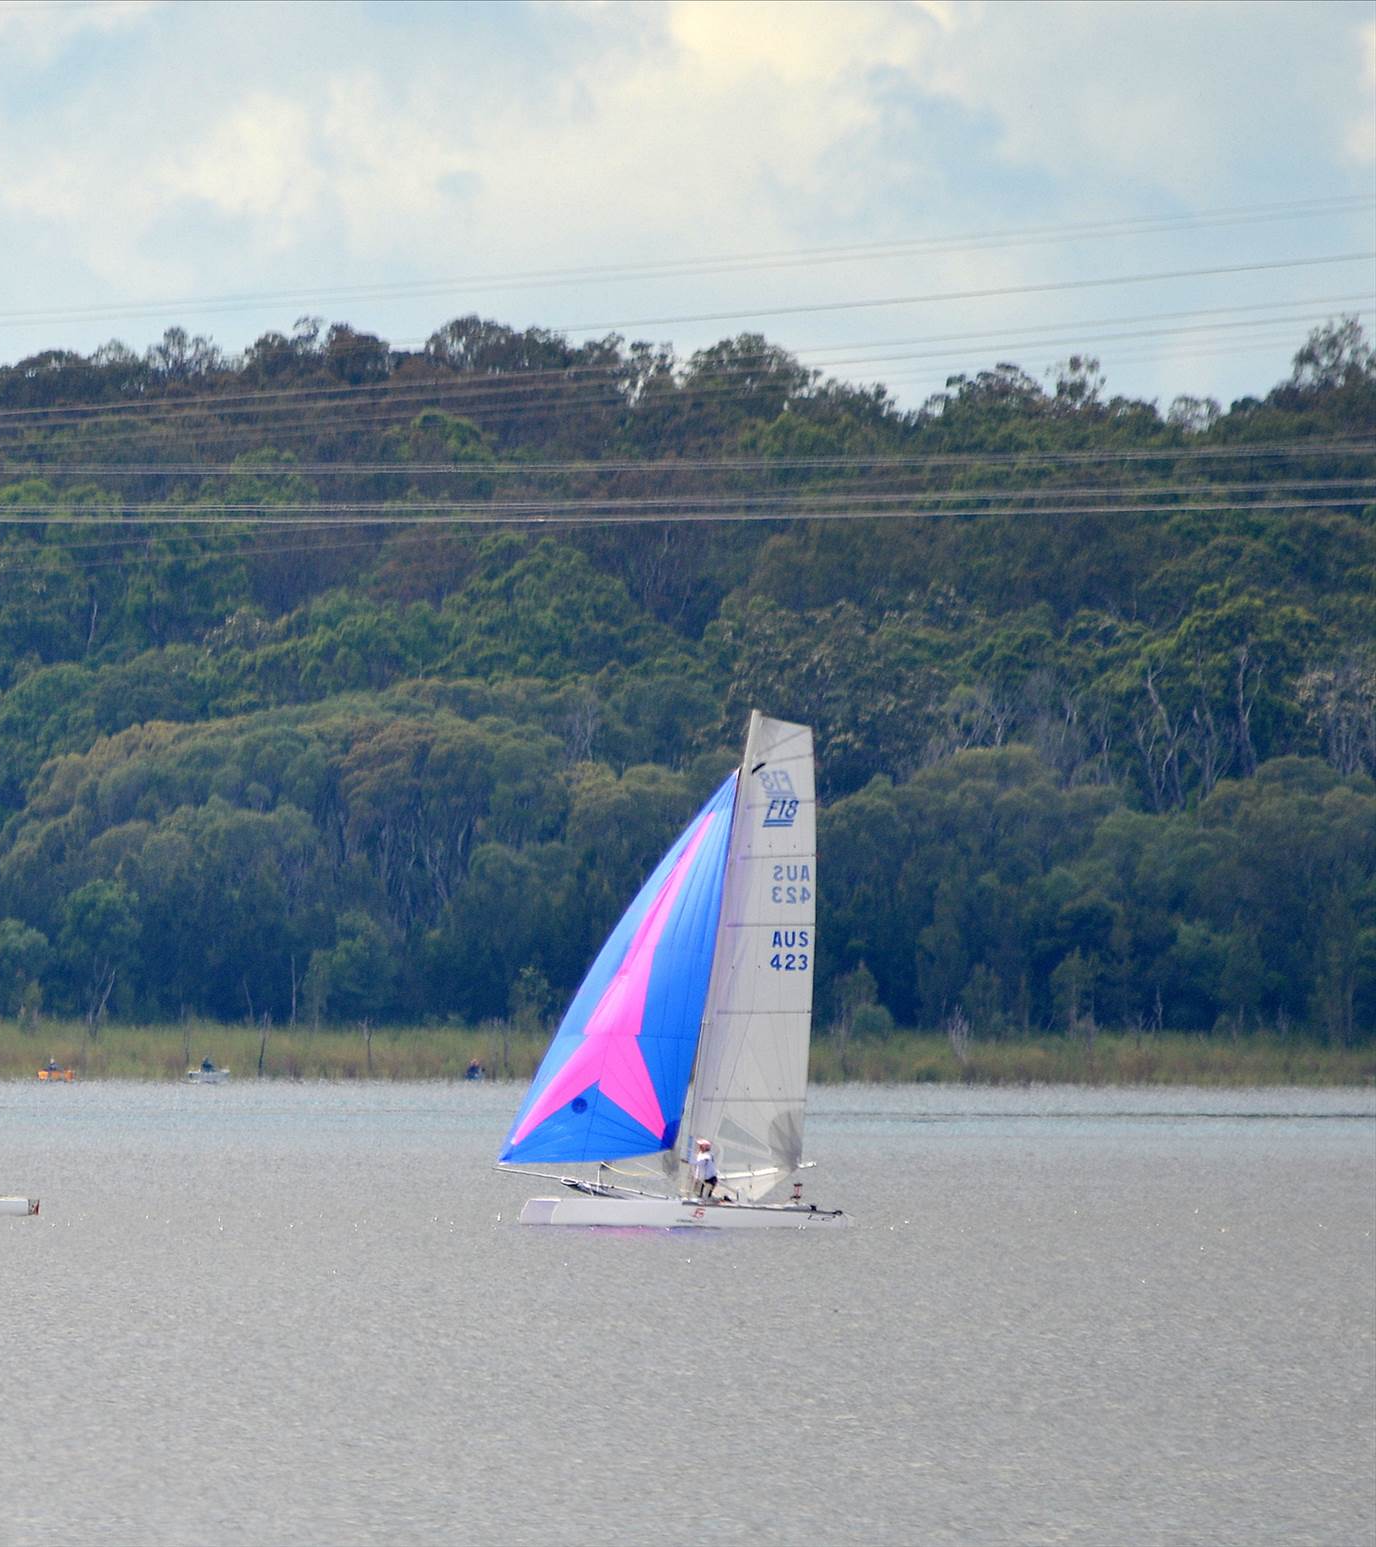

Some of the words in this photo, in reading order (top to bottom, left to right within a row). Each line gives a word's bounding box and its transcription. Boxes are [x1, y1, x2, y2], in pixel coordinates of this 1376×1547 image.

[766, 799, 800, 819] F18
[772, 931, 809, 948] AUS
[770, 954, 809, 971] 423
